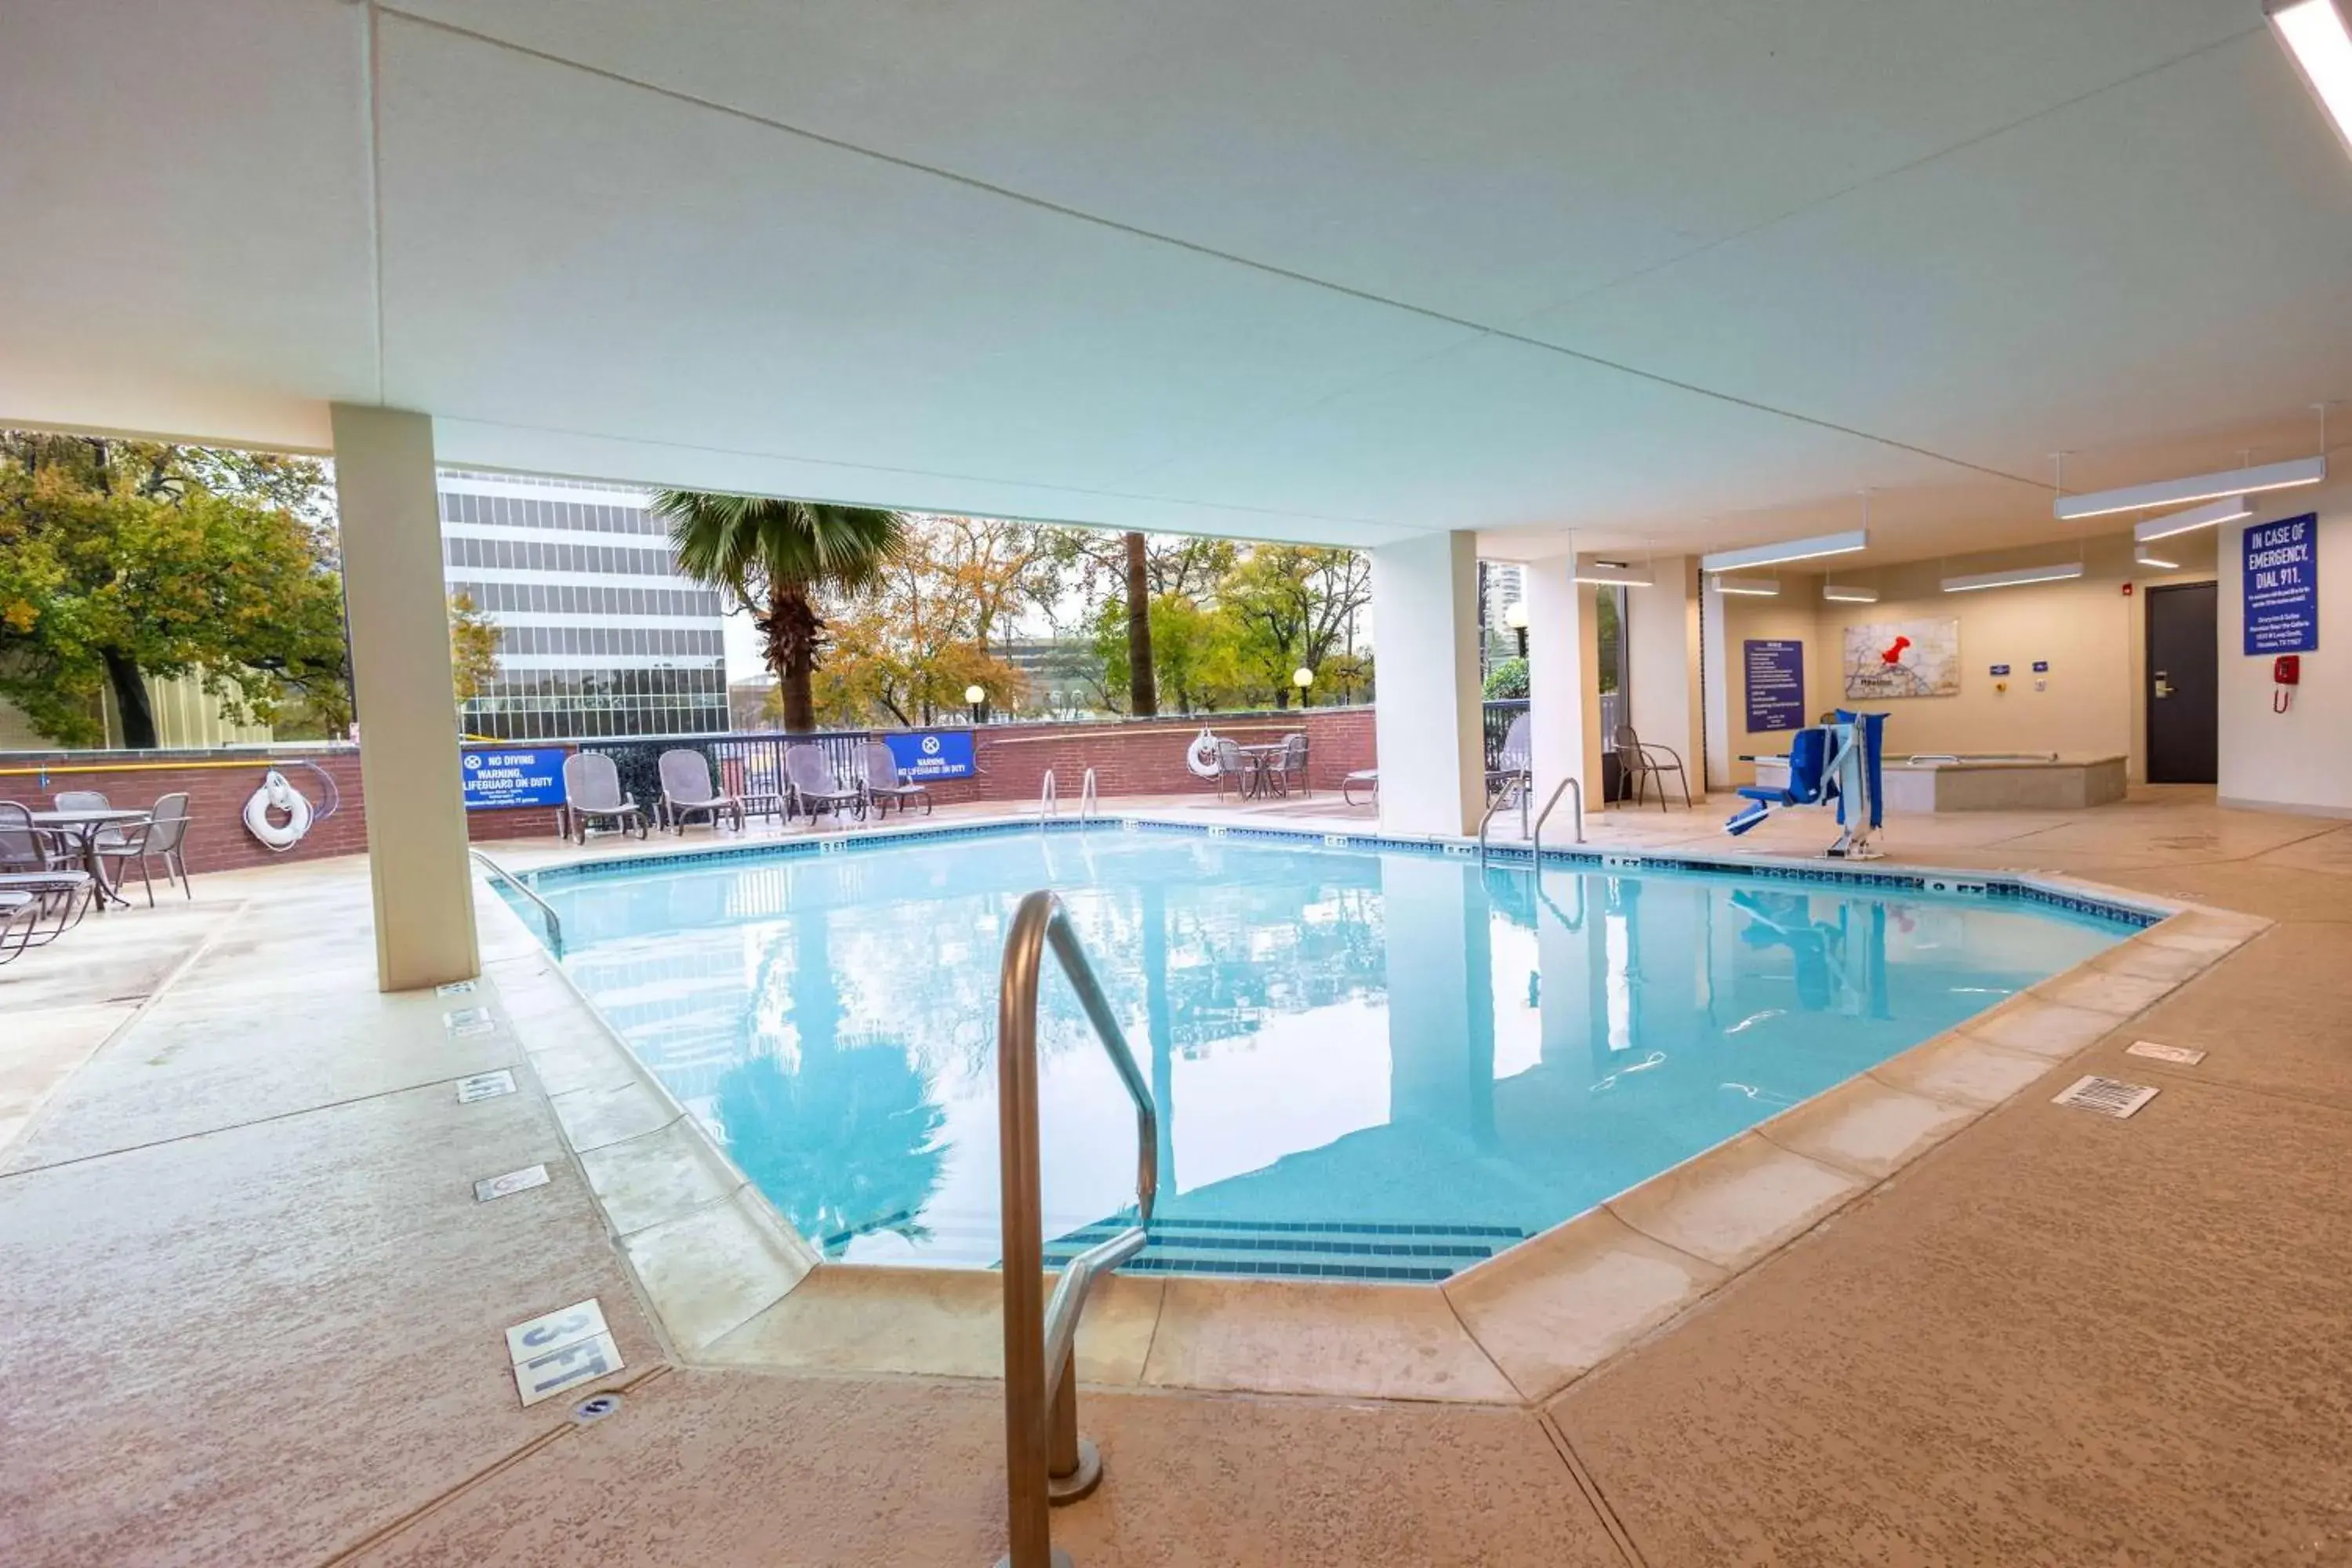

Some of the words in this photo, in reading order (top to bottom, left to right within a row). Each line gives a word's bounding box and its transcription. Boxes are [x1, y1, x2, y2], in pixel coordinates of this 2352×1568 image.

[2252, 532, 2262, 549] IN
[2264, 526, 2290, 546] CASE
[2292, 522, 2305, 541] OF
[2256, 570, 2278, 590] DIAL
[2281, 566, 2301, 585] 911.
[488, 756, 502, 766] NO
[503, 755, 535, 766] DIVING
[463, 779, 514, 791] LIFEGUARD
[515, 777, 528, 788] ON
[530, 777, 553, 787] DUTY
[528, 1338, 608, 1393] FT
